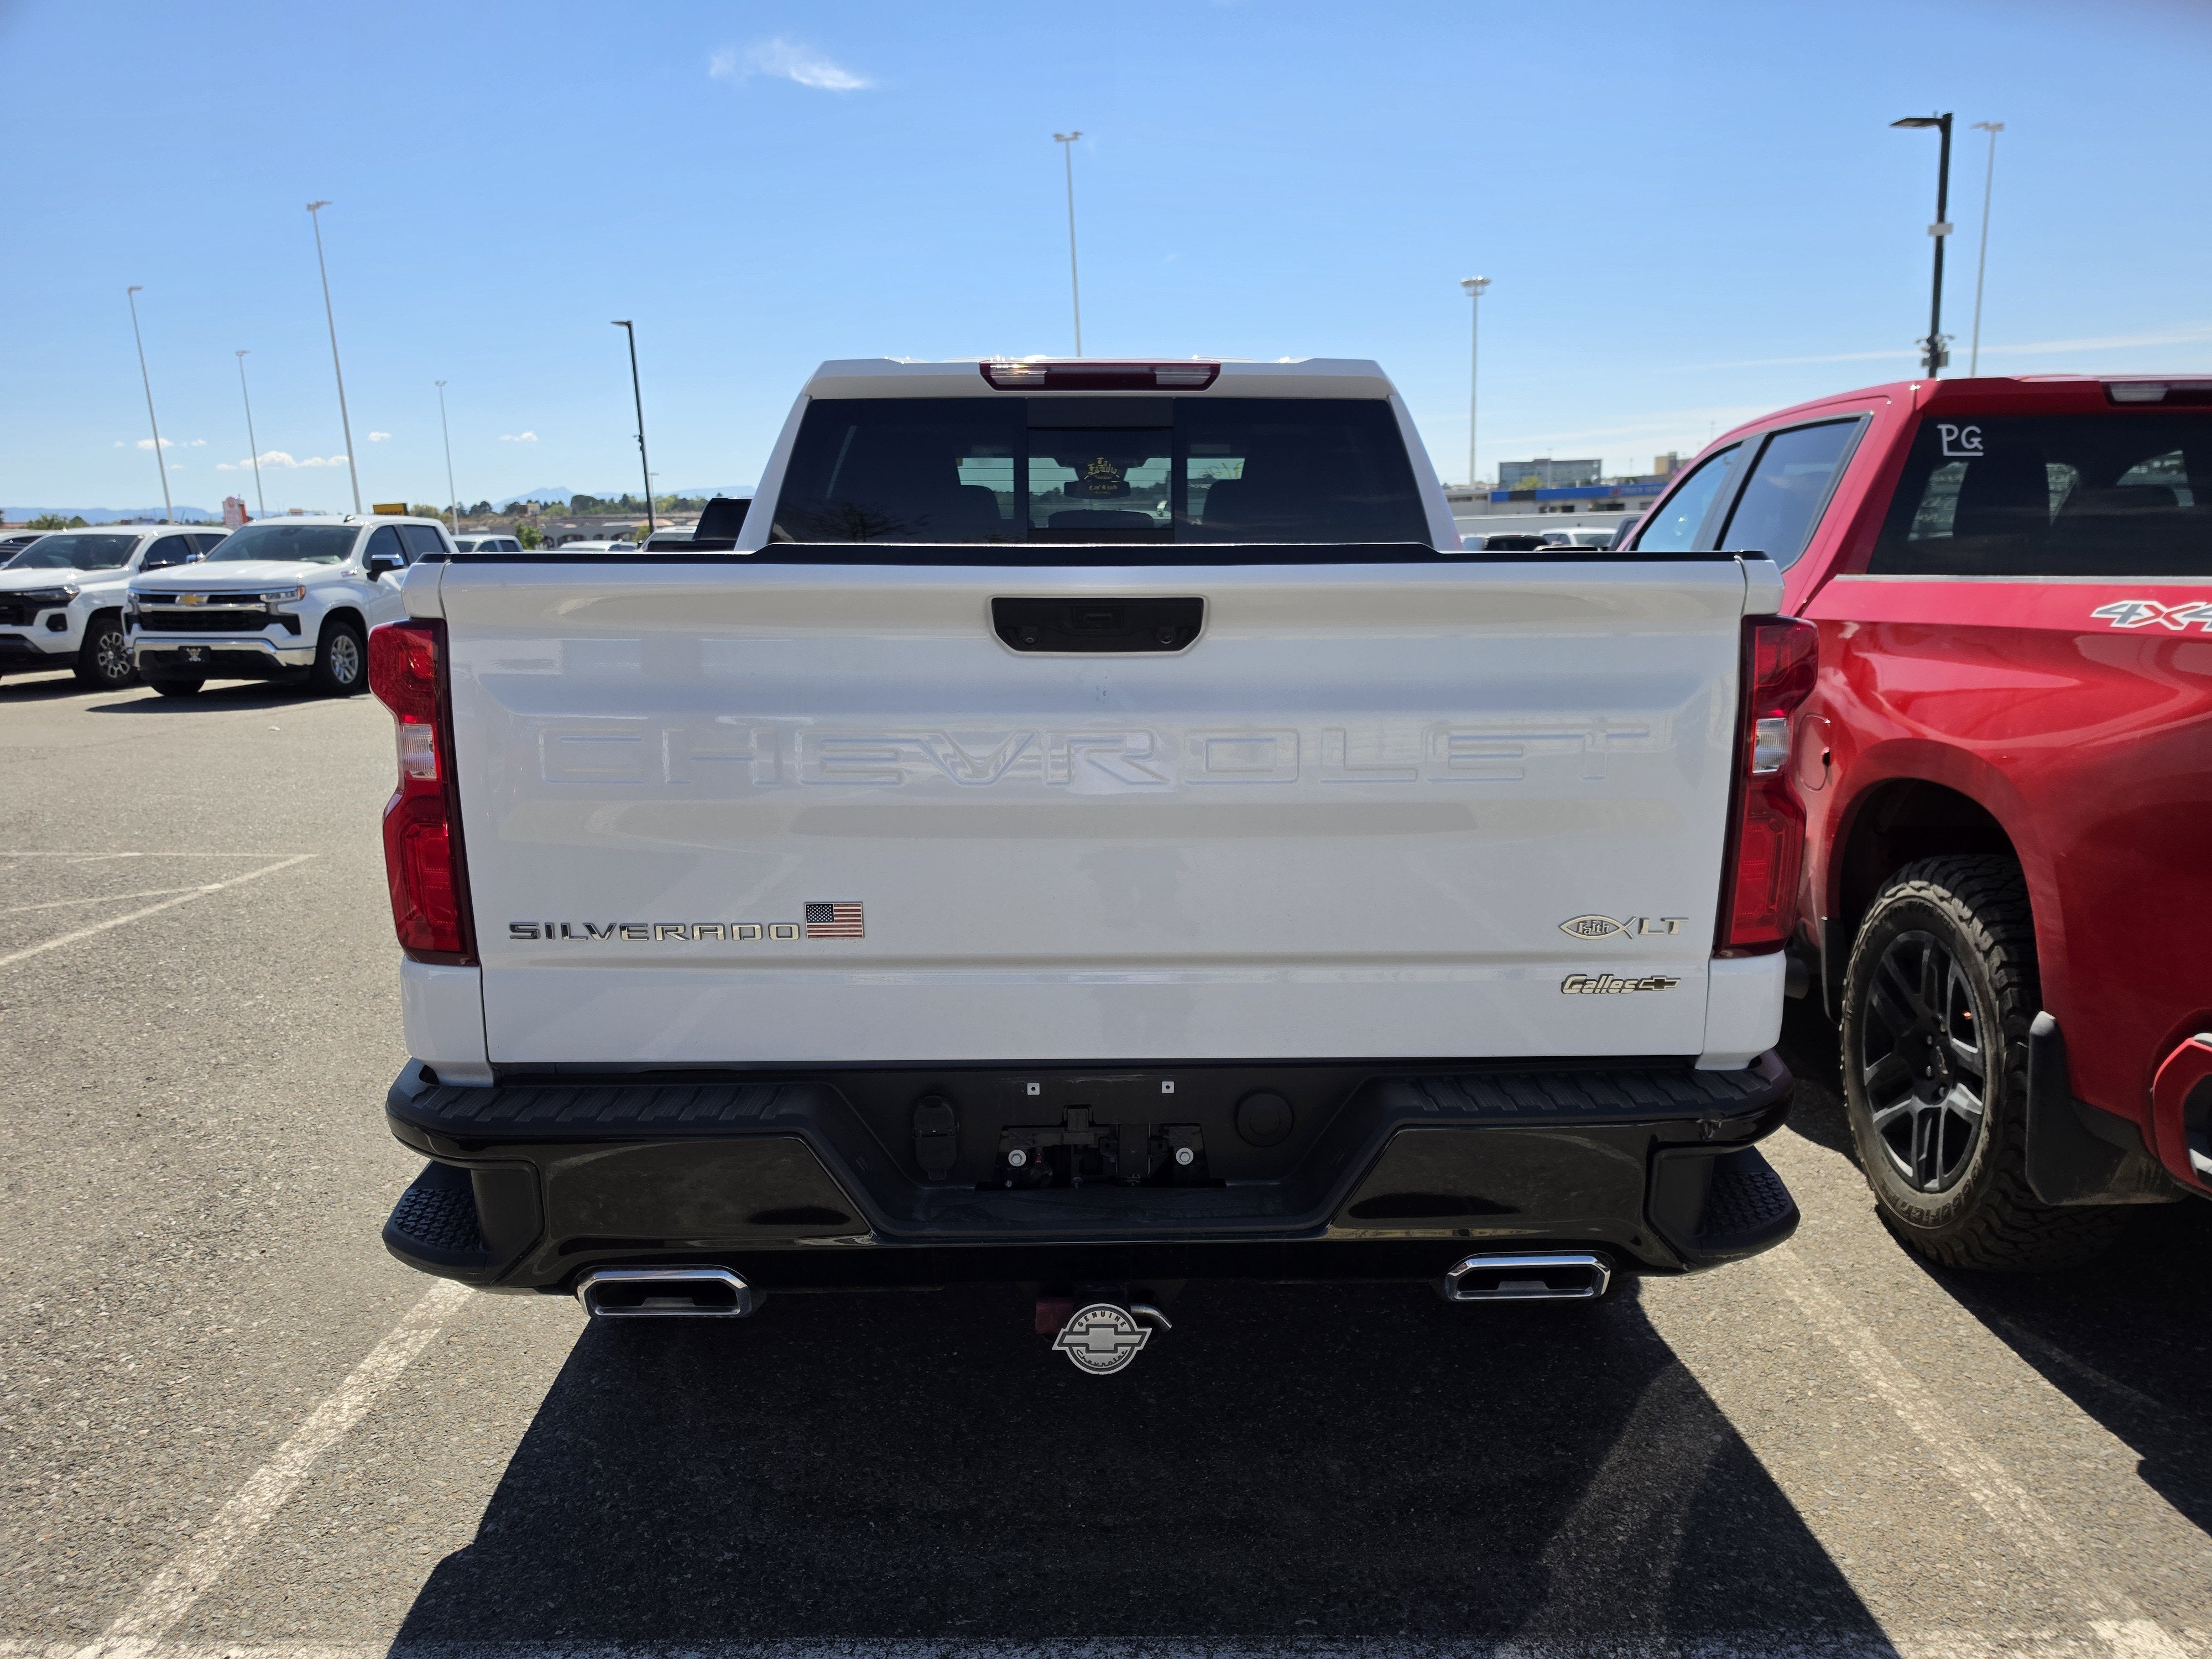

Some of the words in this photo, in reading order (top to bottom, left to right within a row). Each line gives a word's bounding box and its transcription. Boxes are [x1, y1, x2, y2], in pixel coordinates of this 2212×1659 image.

[1937, 424, 1984, 456] PG
[538, 723, 1650, 785] CHEVROLET
[508, 922, 801, 941] SILVERADO
[1577, 920, 1610, 935] Faith
[1638, 917, 1689, 935] LT
[1561, 973, 1639, 994] Galles
[1077, 1311, 1126, 1328] GENUINE
[1076, 1349, 1128, 1368] Chevrolet
